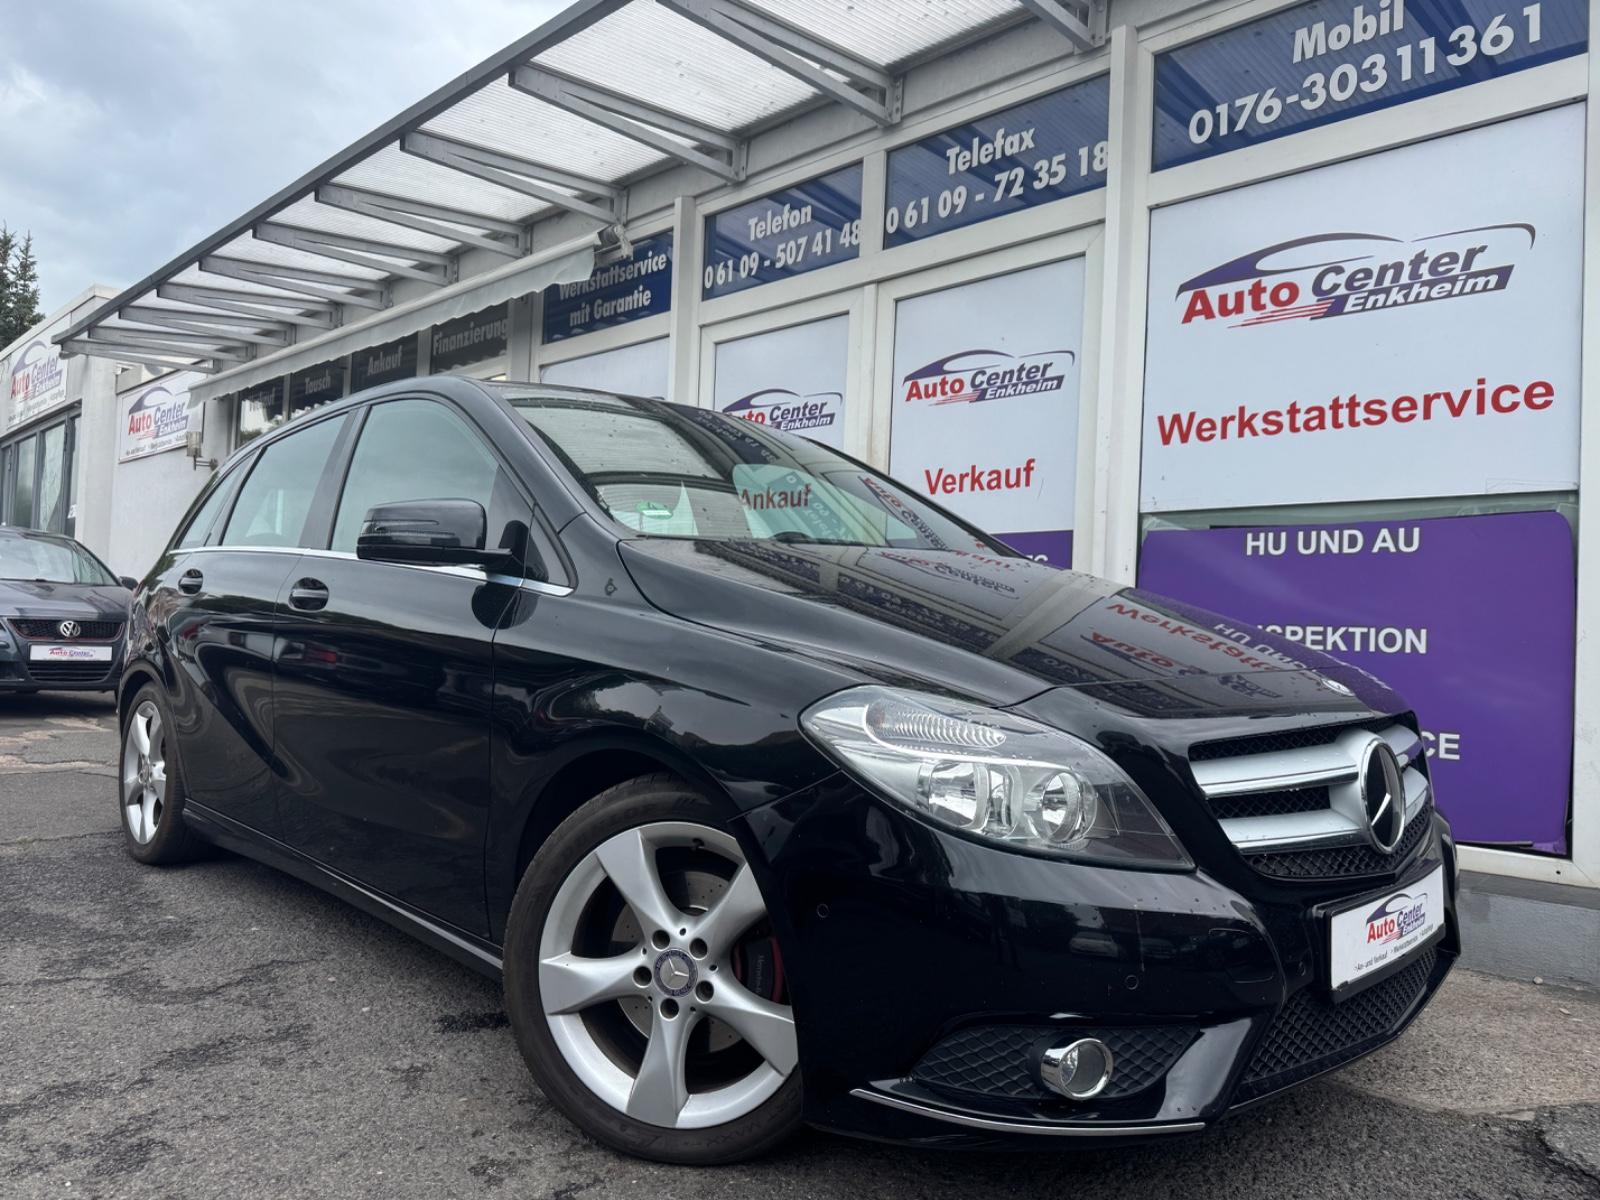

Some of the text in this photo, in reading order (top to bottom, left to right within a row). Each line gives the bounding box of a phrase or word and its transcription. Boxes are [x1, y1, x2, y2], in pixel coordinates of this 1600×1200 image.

[1292, 0, 1405, 64] Mobil
[946, 128, 1036, 175] Telefax
[885, 207, 899, 234] 0
[904, 197, 929, 228] 61
[938, 185, 967, 218] 09
[993, 167, 1025, 203] 72
[1032, 153, 1066, 190] 35
[1078, 140, 1108, 177] 18
[748, 203, 812, 242] Telefon
[704, 265, 714, 289] 0
[716, 260, 733, 286] 61
[740, 252, 760, 278] 09
[775, 236, 809, 269] 507
[811, 228, 832, 257] 41
[840, 219, 861, 248] 48
[560, 251, 667, 300] Werkstattservice
[1181, 245, 1488, 325] Auto Center
[1343, 271, 1500, 312] Enkheim
[570, 285, 651, 327] mit Garantie
[433, 319, 508, 356] Finanzierung
[11, 356, 58, 399] Auto Center
[367, 345, 403, 376] Ankauf
[905, 359, 1053, 402] Auto Center
[305, 369, 331, 395] Tausch
[985, 377, 1059, 399] Enkheim
[129, 401, 186, 435] Auto Center
[770, 401, 828, 421] Center
[780, 416, 830, 431] Enkheim
[1157, 378, 1555, 446] Werkstattservice
[741, 483, 811, 510] Ankauf
[925, 458, 1036, 495] Verkauf
[1246, 527, 1421, 557] HU UND AU
[49, 649, 68, 657] Auto
[1367, 917, 1396, 944] Auto
[1397, 903, 1423, 927] Center
